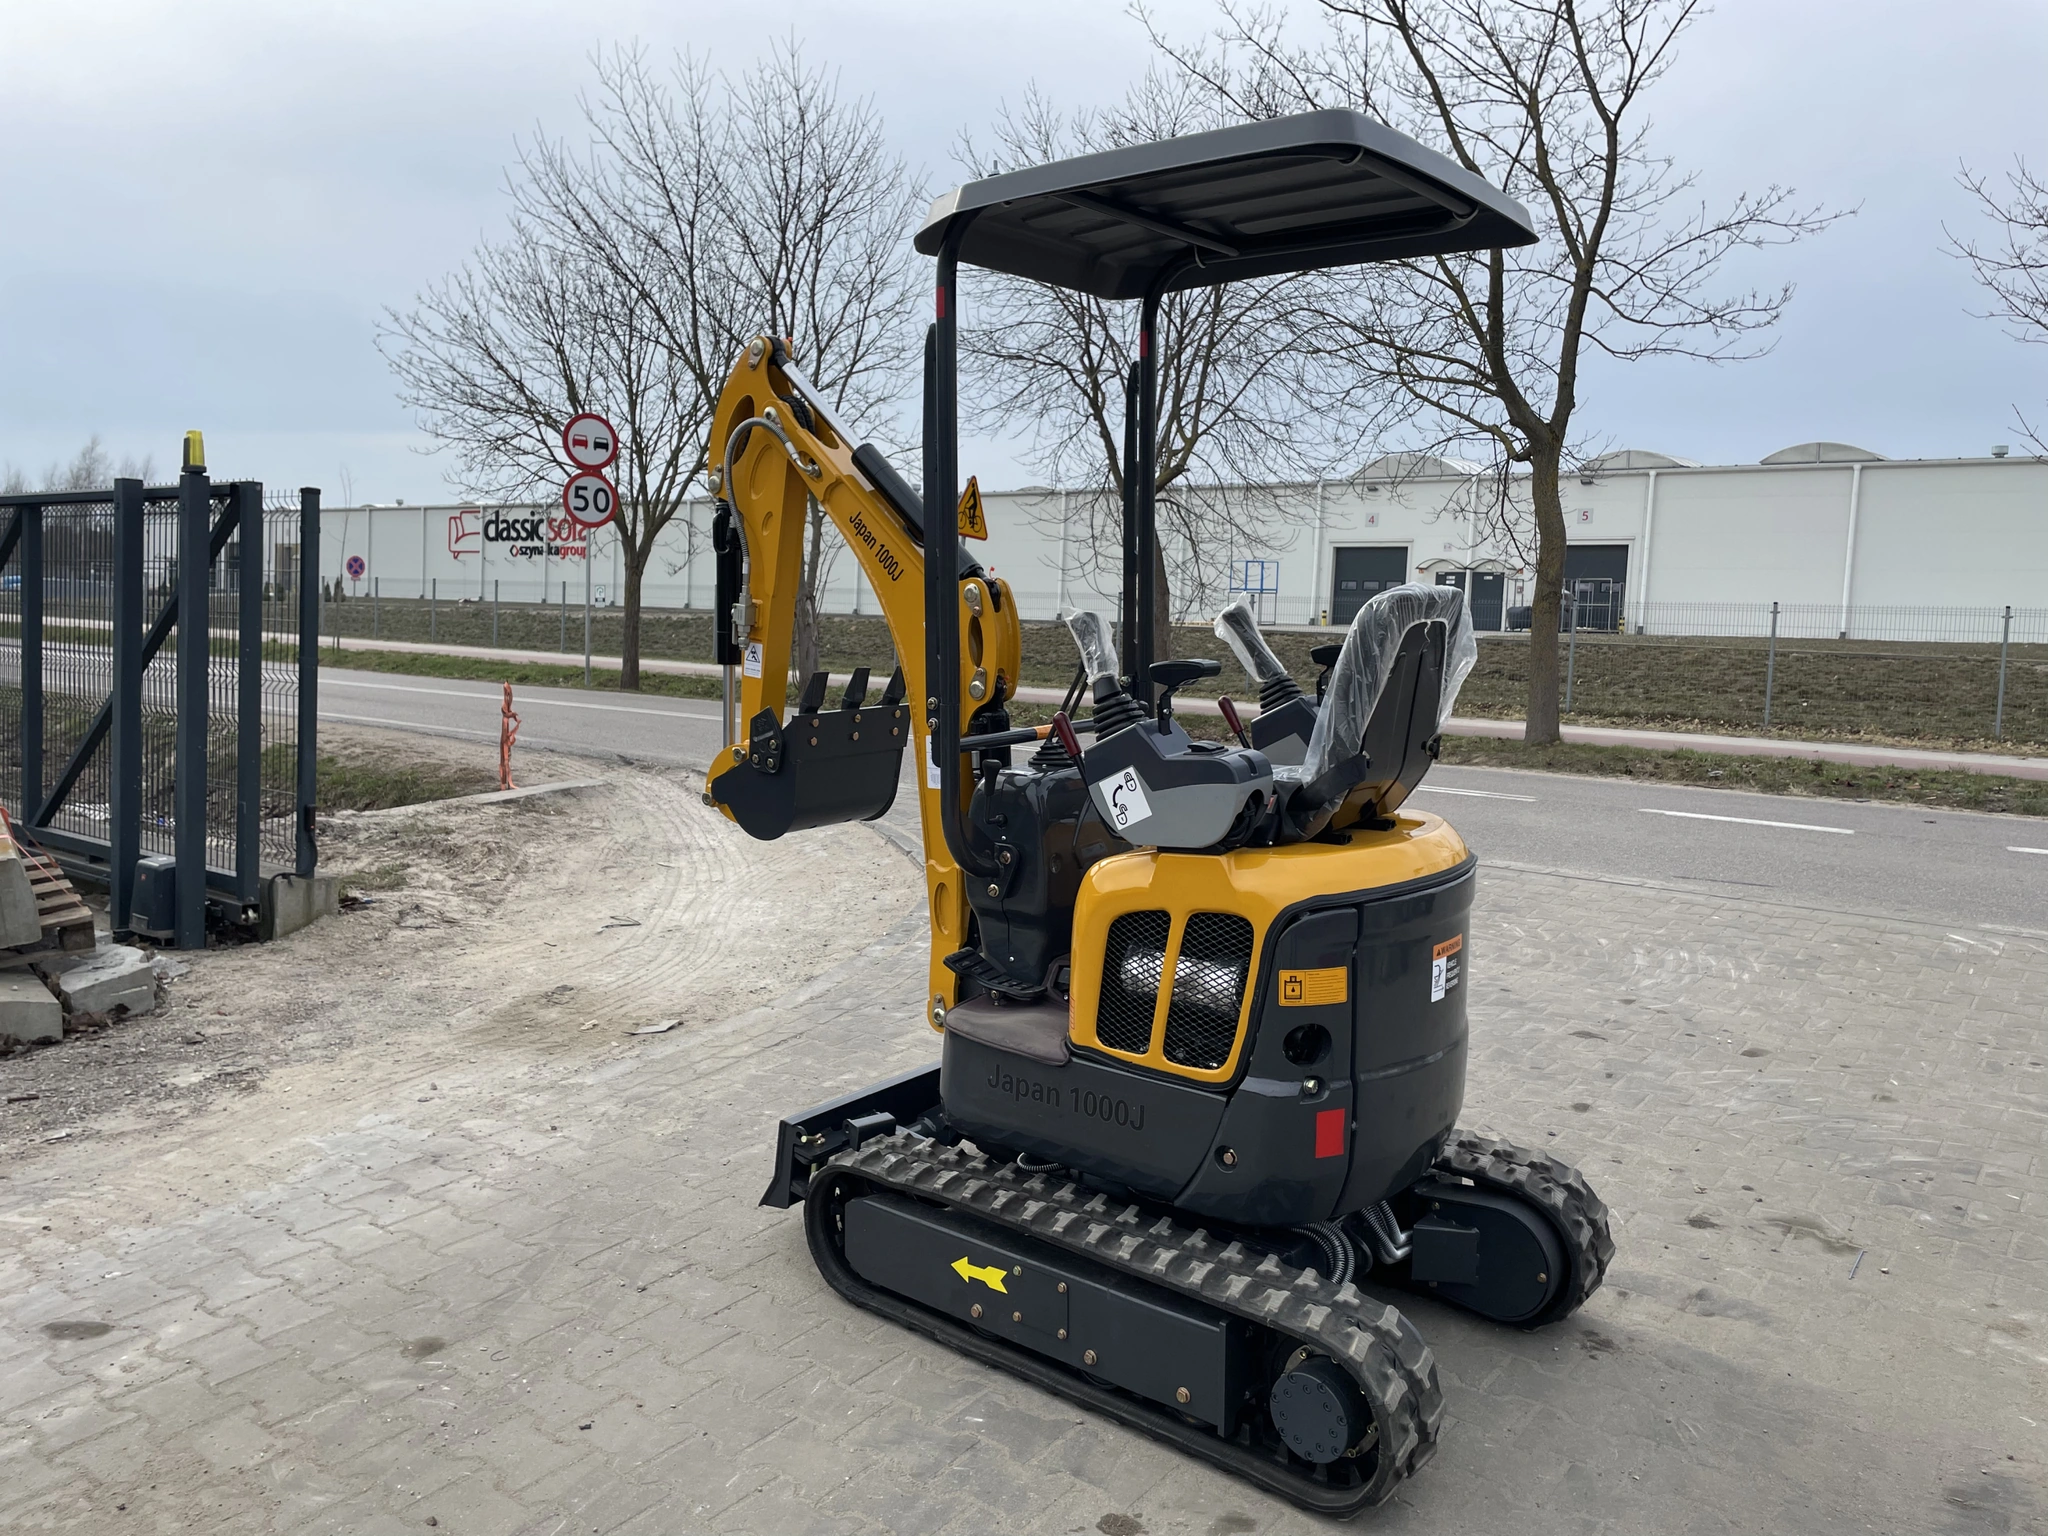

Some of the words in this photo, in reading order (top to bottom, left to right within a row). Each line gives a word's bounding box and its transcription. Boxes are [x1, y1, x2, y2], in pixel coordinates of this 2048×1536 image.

[573, 485, 610, 513] 50
[1368, 515, 1375, 525] 4
[1581, 510, 1589, 521] 5
[849, 511, 877, 551] Japan
[875, 543, 905, 582] 1000J
[987, 1064, 1061, 1108] Japan
[1069, 1087, 1145, 1132] 1000J
